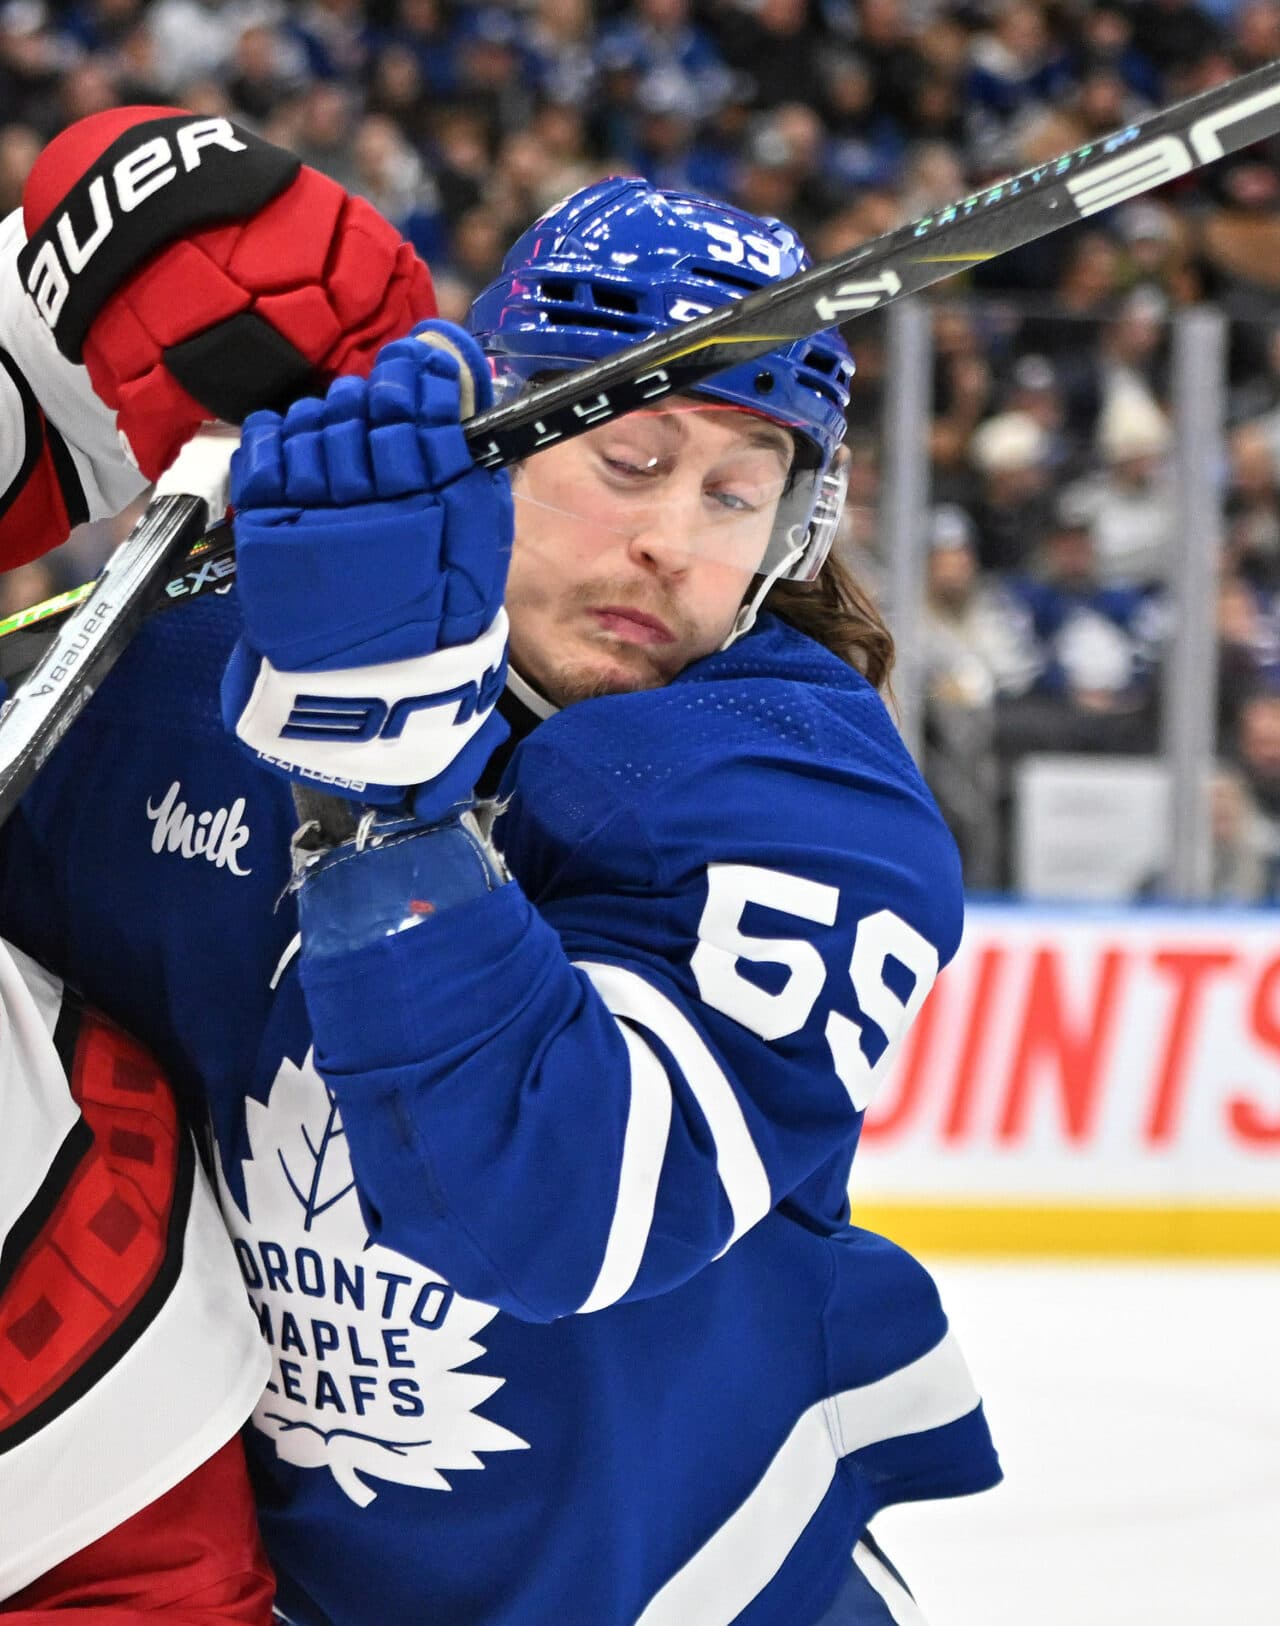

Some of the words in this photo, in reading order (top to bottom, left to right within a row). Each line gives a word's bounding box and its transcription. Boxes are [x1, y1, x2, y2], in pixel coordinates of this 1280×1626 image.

[147, 781, 252, 876] Milk
[690, 862, 939, 1112] 59
[266, 1359, 424, 1418] EAFS
